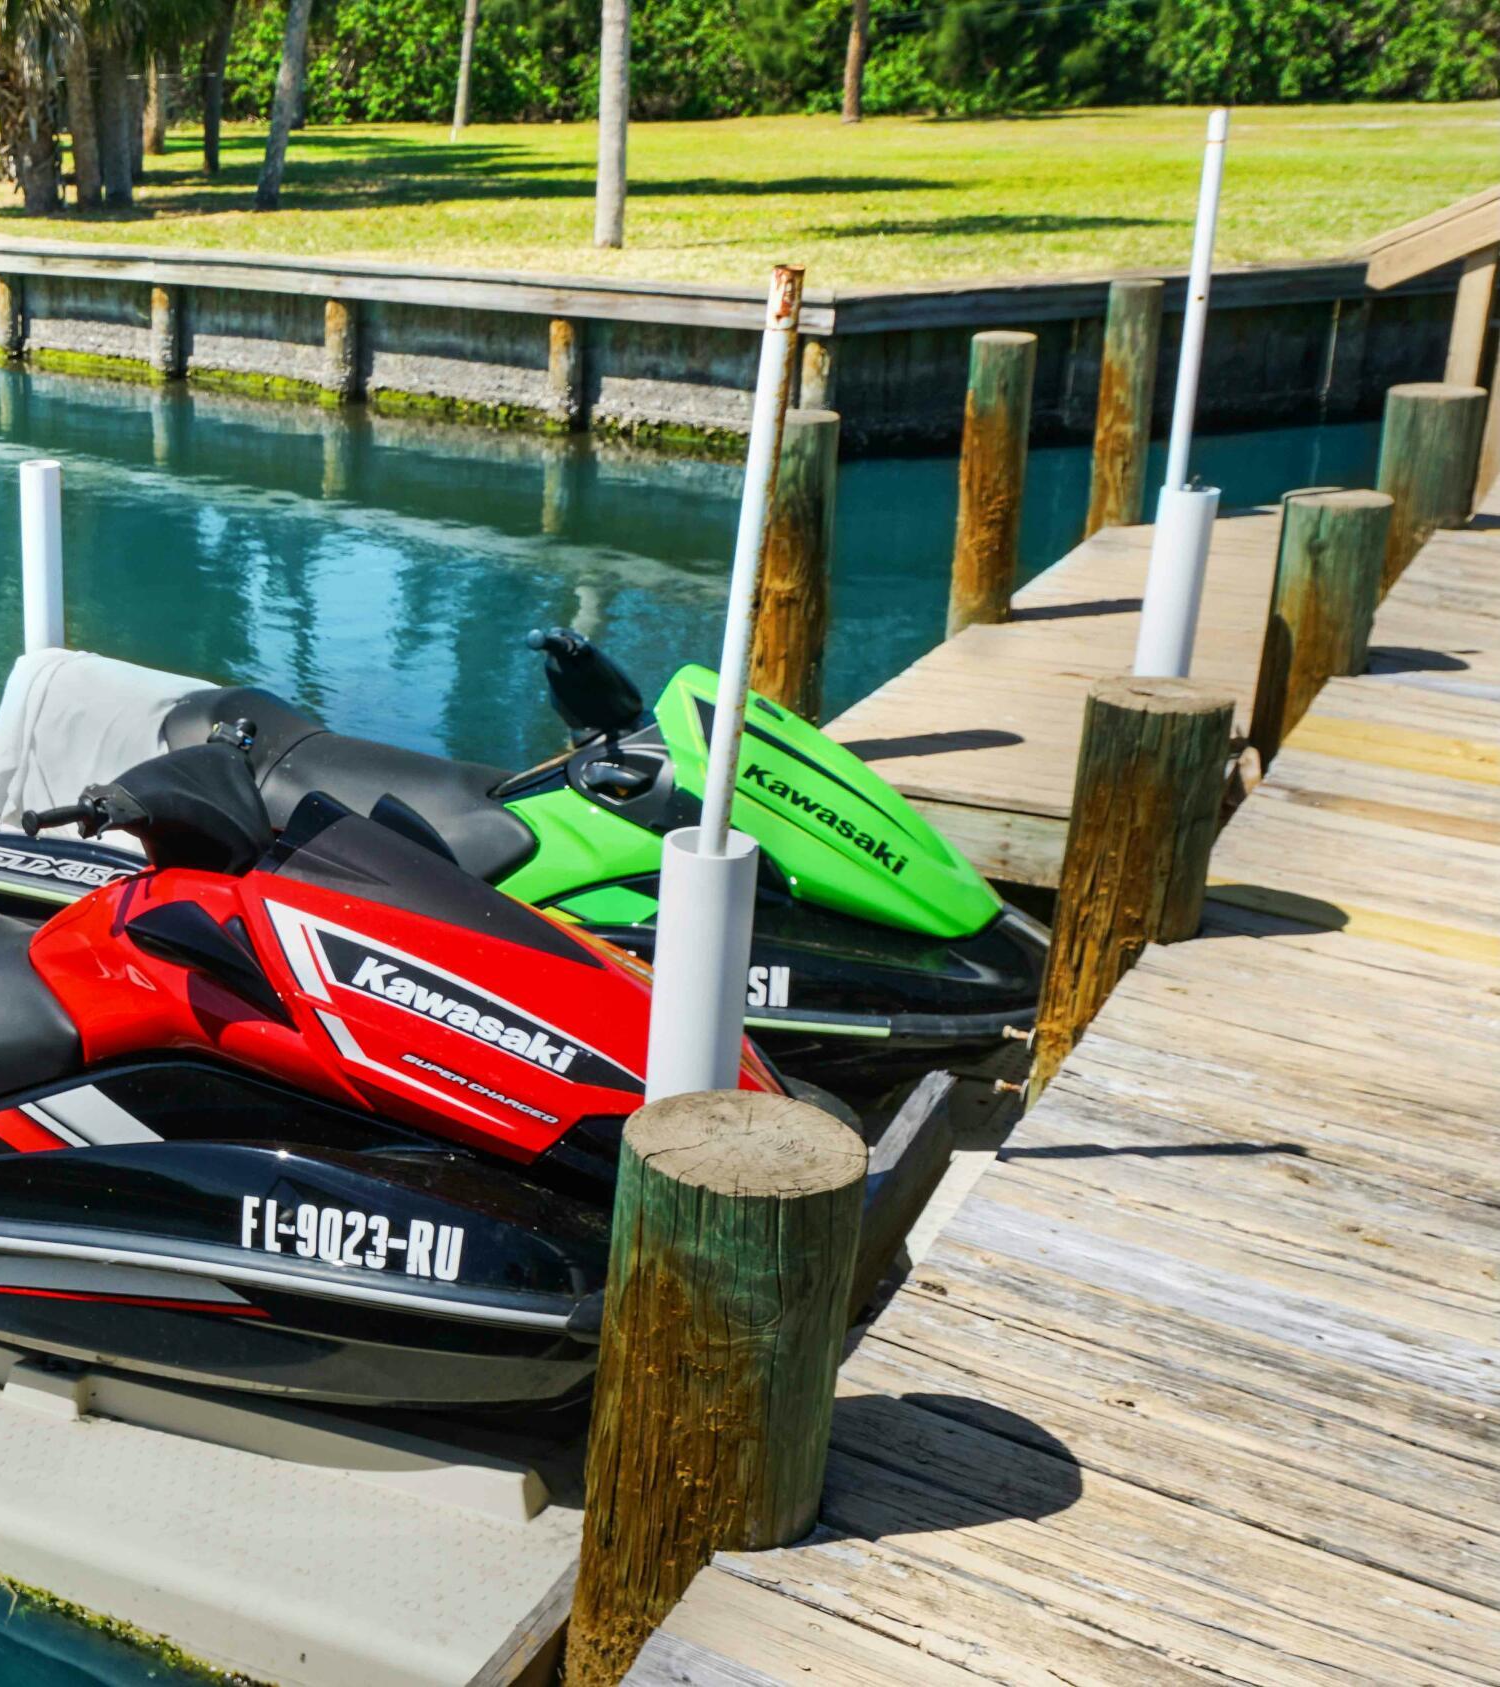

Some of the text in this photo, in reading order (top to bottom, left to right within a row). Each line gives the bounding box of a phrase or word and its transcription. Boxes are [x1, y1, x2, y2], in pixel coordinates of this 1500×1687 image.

[743, 764, 908, 875] Kawasaki
[352, 956, 578, 1074] Kawasaki
[401, 1054, 560, 1125] SUPER CHARGED
[241, 1195, 465, 1282] FL-9023-RU
